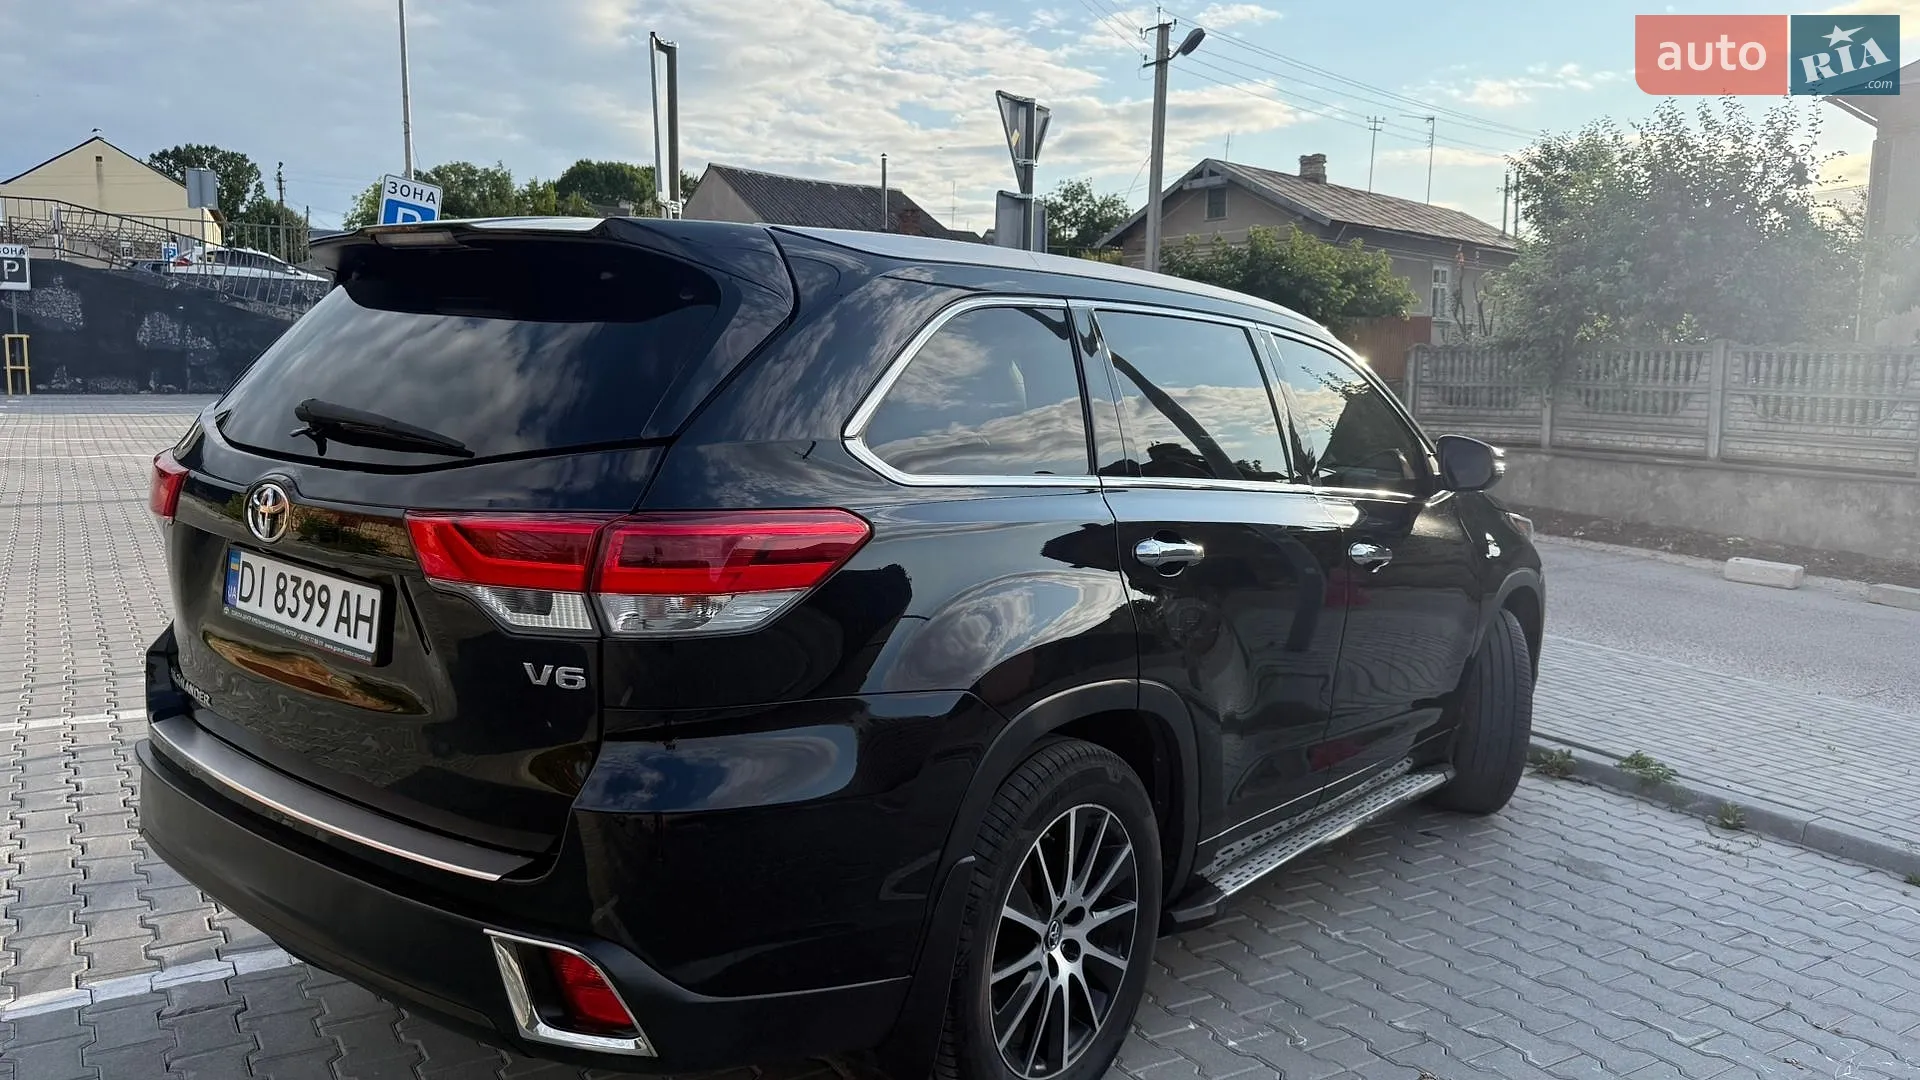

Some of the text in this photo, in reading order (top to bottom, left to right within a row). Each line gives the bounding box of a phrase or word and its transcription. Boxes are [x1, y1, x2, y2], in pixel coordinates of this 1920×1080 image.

[387, 181, 436, 204] ЗОНА
[227, 585, 237, 599] UA
[238, 560, 266, 608] DI
[273, 572, 331, 628] 8399
[333, 590, 376, 644] AH
[523, 662, 586, 690] V6
